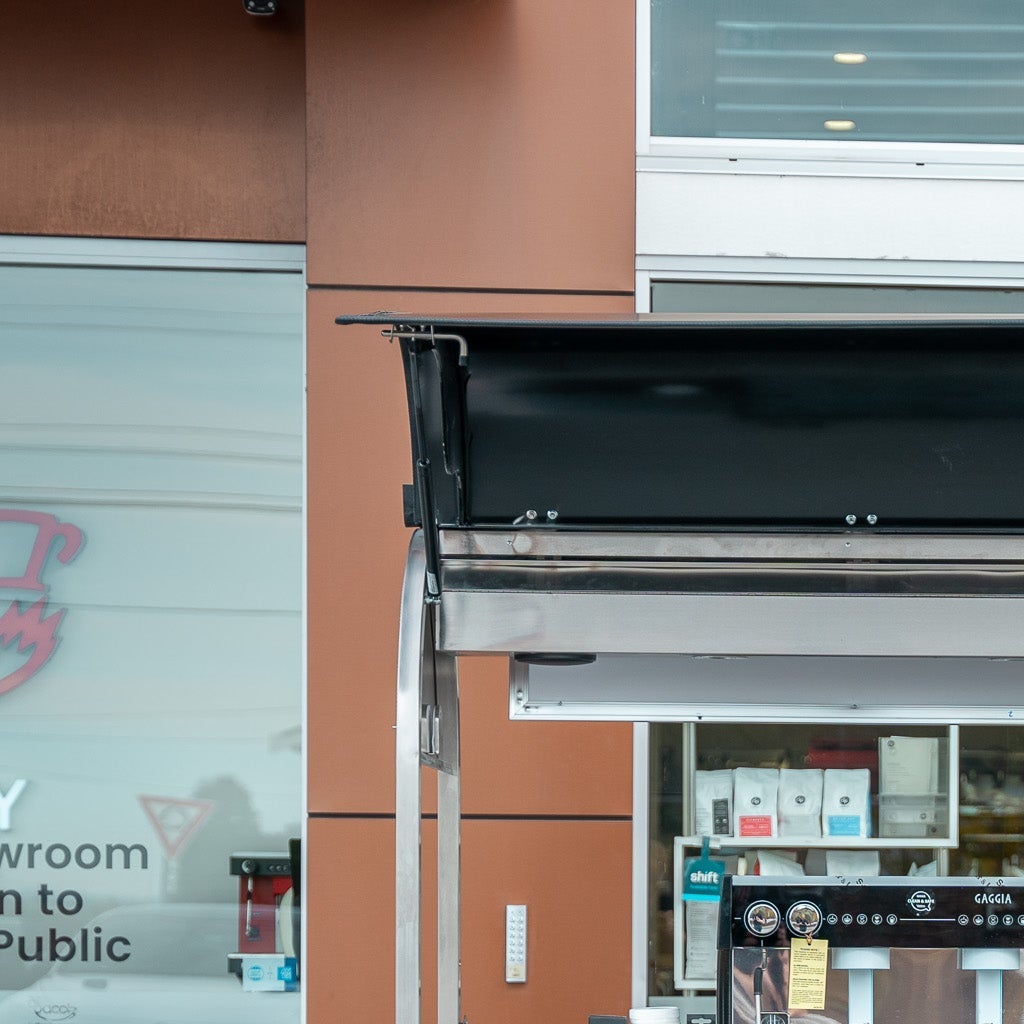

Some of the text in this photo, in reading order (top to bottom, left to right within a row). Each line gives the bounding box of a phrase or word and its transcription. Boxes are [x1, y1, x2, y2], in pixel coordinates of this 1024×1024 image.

[0, 843, 149, 870] wroom
[690, 870, 719, 885] shift
[37, 884, 84, 916] to
[974, 893, 1012, 904] GAGGIA
